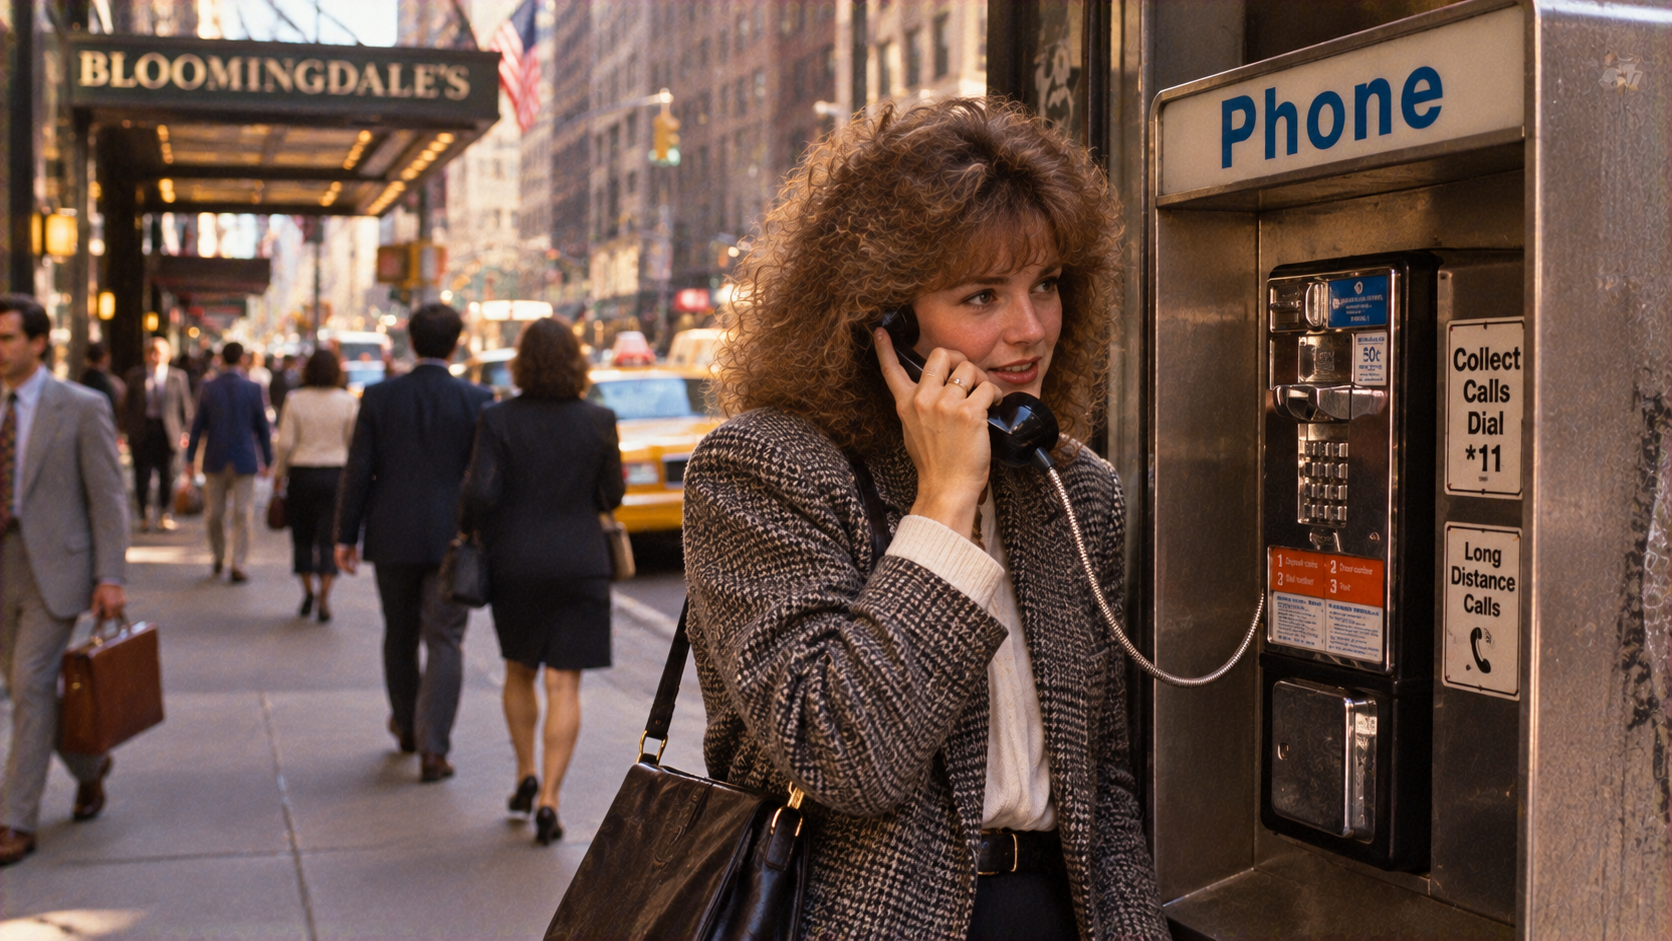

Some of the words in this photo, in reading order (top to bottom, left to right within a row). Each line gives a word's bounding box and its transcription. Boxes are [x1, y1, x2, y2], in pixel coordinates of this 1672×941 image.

[78, 50, 471, 101] BLOOMINGDALE'S
[1221, 66, 1443, 169] Phone
[1453, 346, 1521, 372] Collect
[1463, 378, 1511, 403] Calls
[1467, 411, 1504, 435] Dial
[1277, 553, 1283, 567] 1
[1330, 559, 1337, 573] 2
[1464, 541, 1502, 568] Long
[1329, 578, 1337, 594] 3
[1451, 565, 1516, 592] Distance
[1463, 594, 1501, 618] Calls
